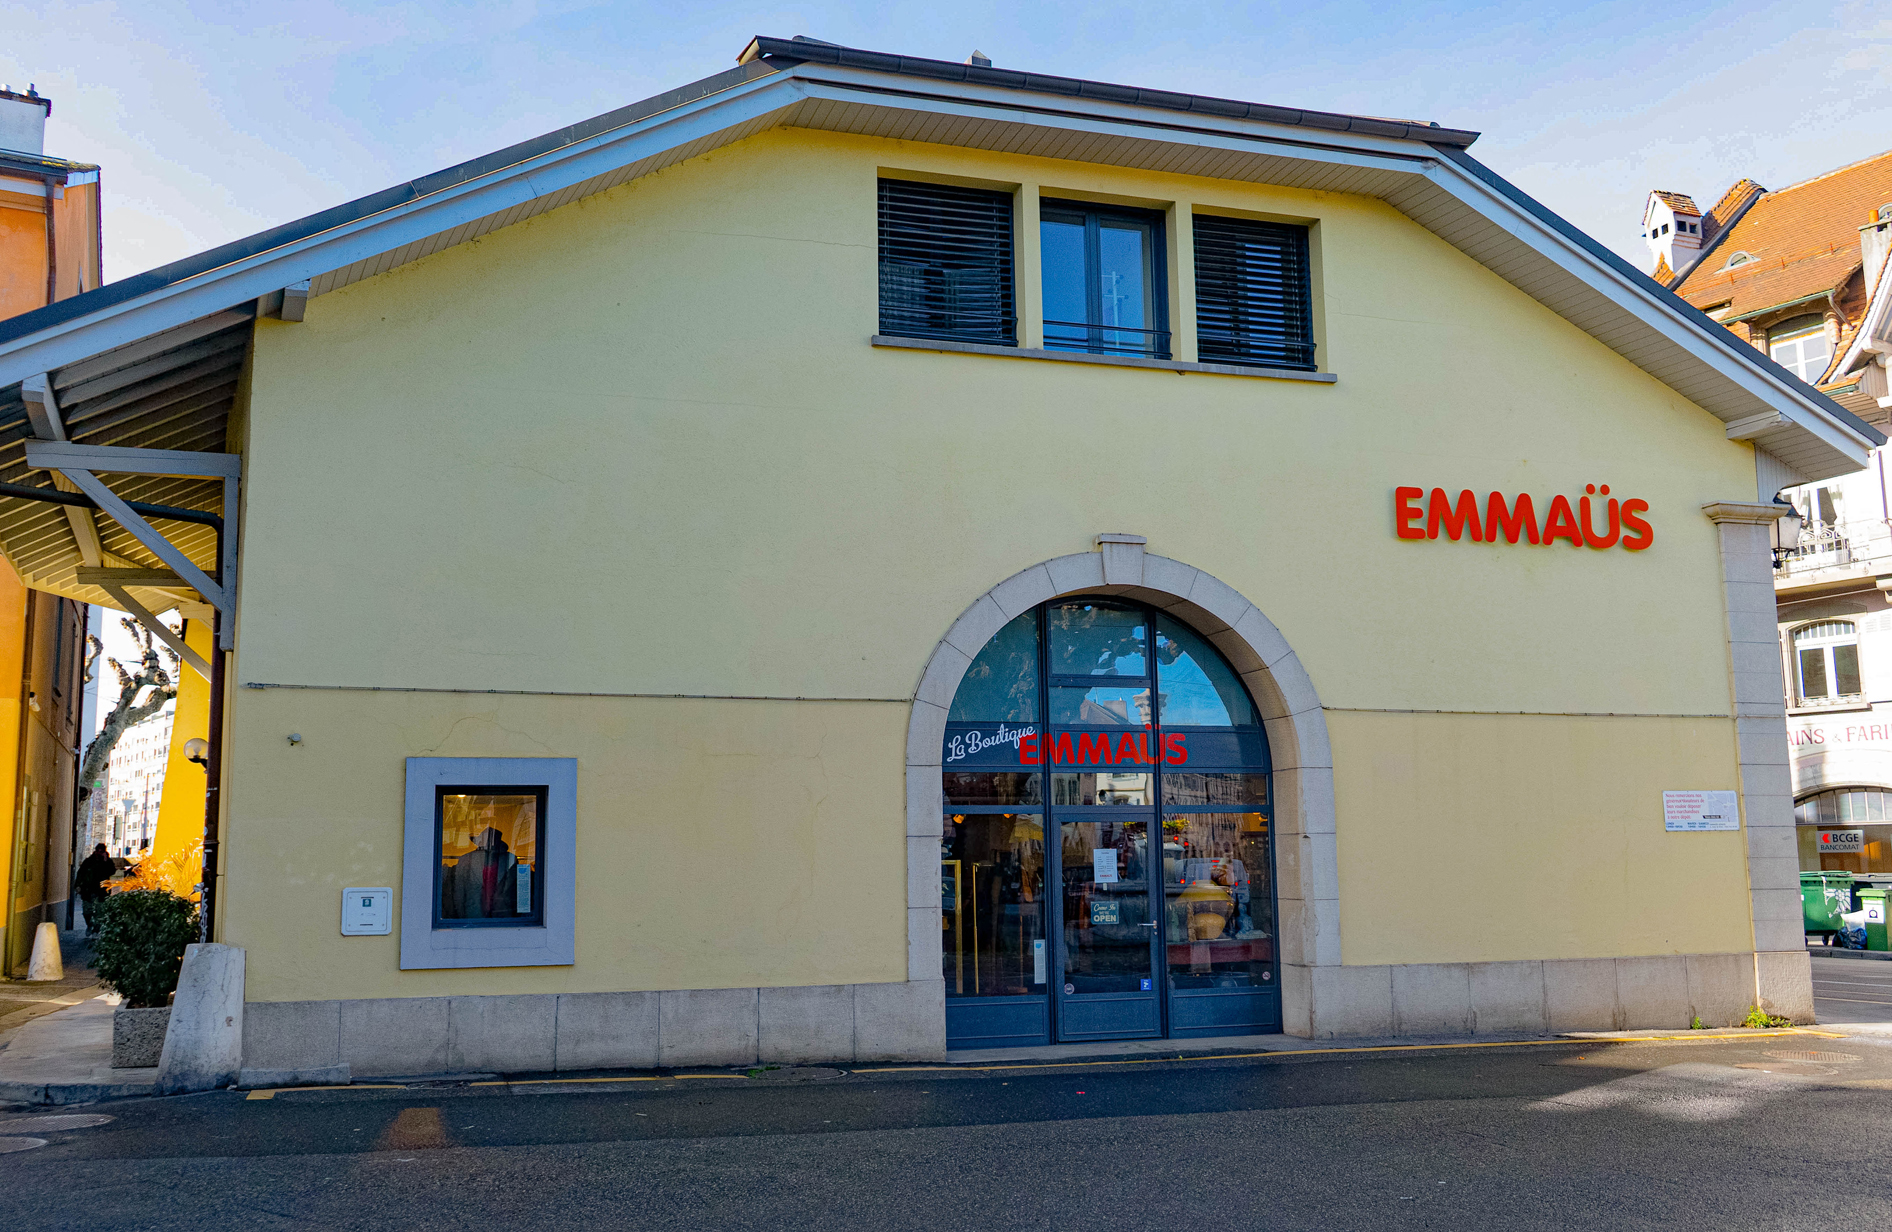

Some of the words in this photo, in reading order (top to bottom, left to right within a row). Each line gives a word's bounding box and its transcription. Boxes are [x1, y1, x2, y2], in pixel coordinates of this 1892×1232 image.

[1395, 483, 1654, 550] EMMAÜS
[946, 735, 965, 762] La
[966, 723, 1035, 754] Boutique
[1019, 723, 1188, 765] EMMAÜS
[1846, 723, 1892, 742] FARI
[1832, 833, 1859, 843] BCGE
[1093, 914, 1116, 922] OPEN
